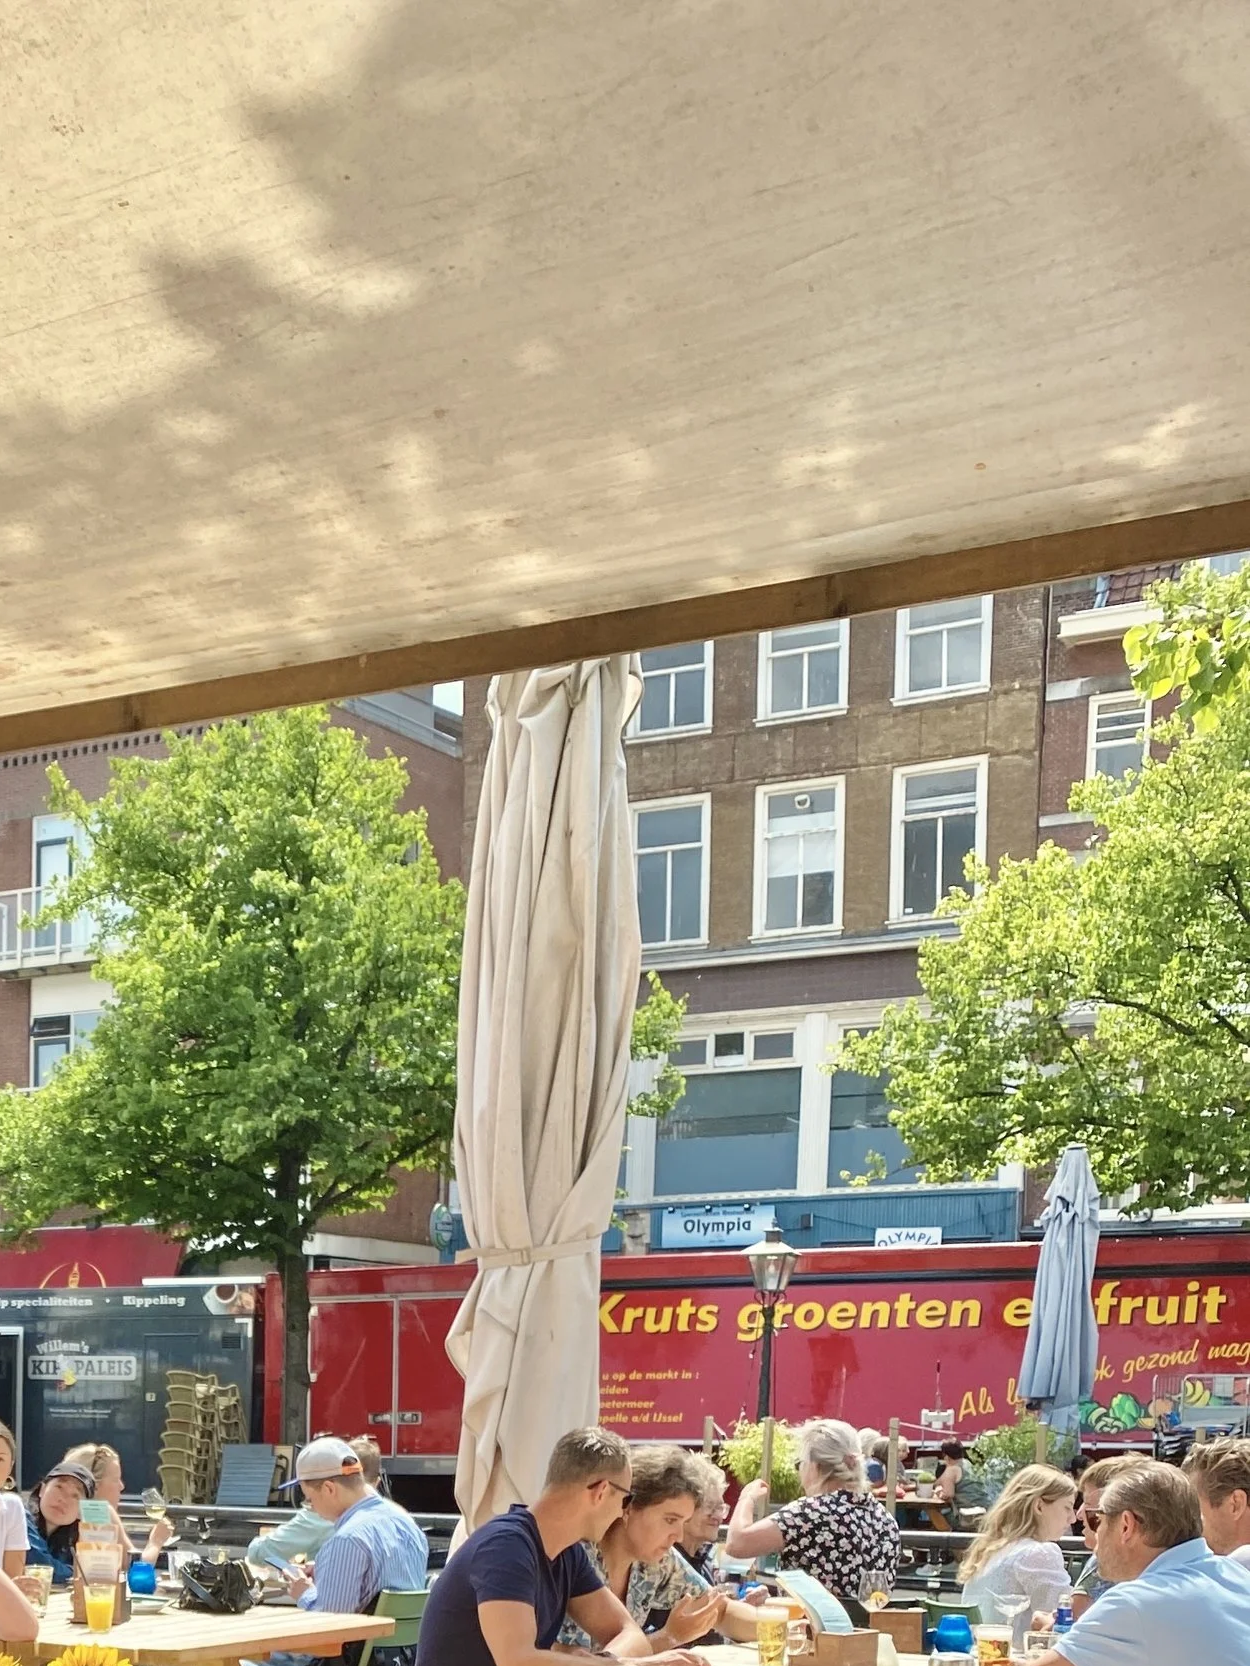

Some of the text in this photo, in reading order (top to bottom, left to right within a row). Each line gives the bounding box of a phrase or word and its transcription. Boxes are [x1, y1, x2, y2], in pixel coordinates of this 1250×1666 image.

[683, 1217, 751, 1236] Olympia
[10, 1297, 93, 1309] specialiteiten
[123, 1296, 186, 1307] Kippeling
[599, 1281, 1226, 1341] Kruts groenten e fruit
[36, 1340, 89, 1354] Willem's
[75, 1360, 133, 1376] PALEIS
[612, 1372, 626, 1382] op
[629, 1370, 643, 1380] de
[646, 1369, 678, 1380] markt
[681, 1369, 692, 1379] in
[959, 1387, 995, 1422] Als
[1123, 1339, 1199, 1383] gezond
[599, 1385, 629, 1394] eiden
[632, 1413, 649, 1423] a/d
